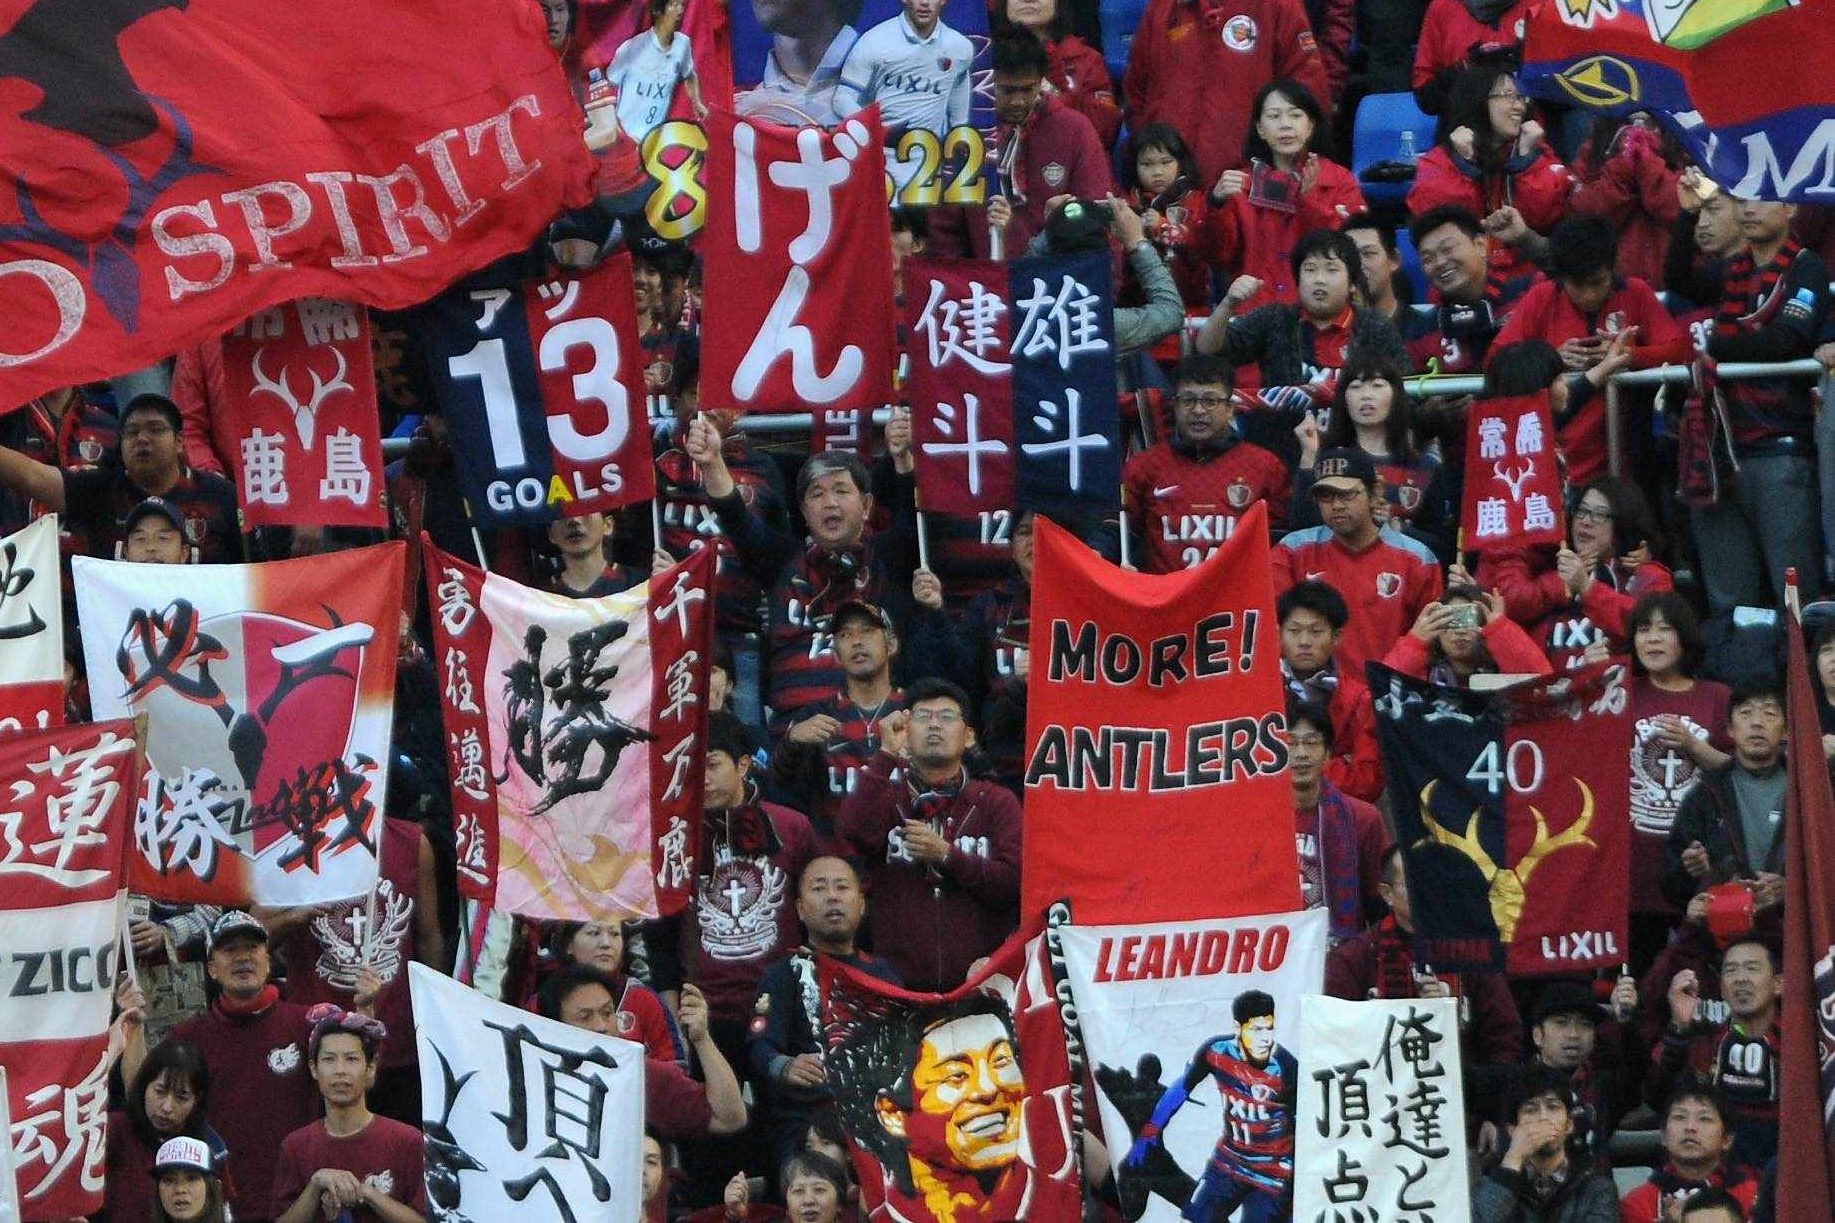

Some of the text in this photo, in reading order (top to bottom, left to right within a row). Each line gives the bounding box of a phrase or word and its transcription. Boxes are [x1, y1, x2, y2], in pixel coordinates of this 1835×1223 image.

[150, 94, 543, 301] SPIRIT
[641, 120, 709, 240] 8
[896, 125, 988, 207] 22
[731, 117, 872, 404] げん
[449, 316, 630, 468] 13
[913, 278, 1014, 497] 健斗
[1009, 273, 1111, 494] 雄斗
[240, 426, 371, 506] 鹿島
[486, 463, 623, 511] GOALS
[978, 510, 1011, 546] 12
[1476, 492, 1556, 537] 鹿島
[1047, 607, 1260, 688] MORE!
[1025, 710, 1290, 792] ANTLERS
[1466, 738, 1544, 794] 40
[1092, 923, 1291, 985] LEANDRO
[1540, 930, 1619, 960] LIXIL
[1055, 981, 1083, 1064] GOAL
[1372, 1005, 1451, 1223] 俺達と
